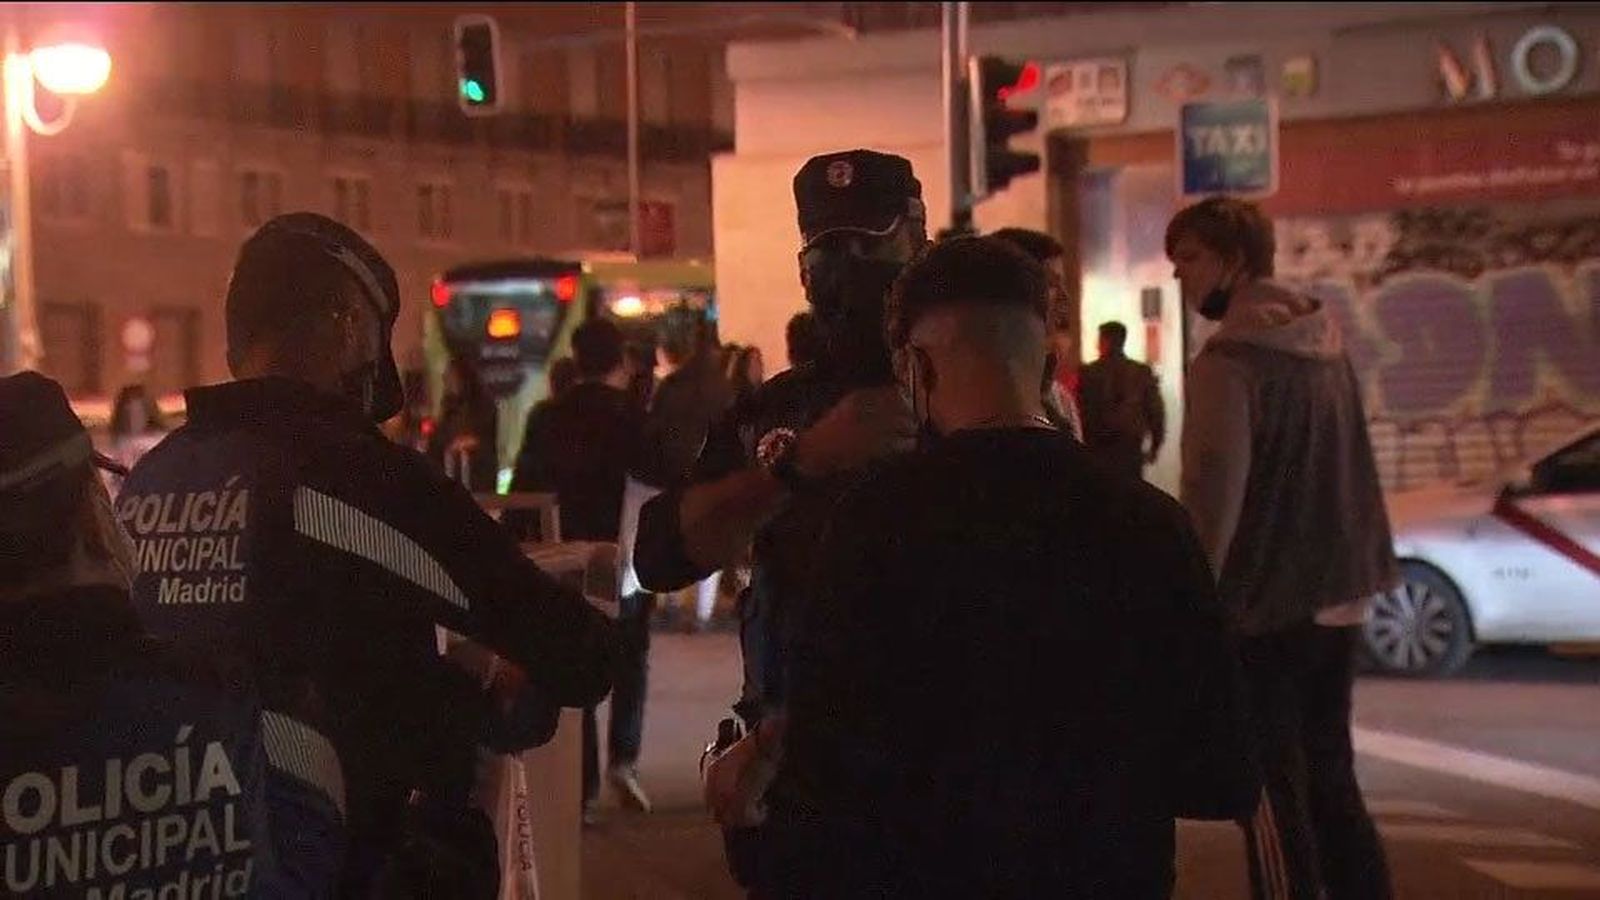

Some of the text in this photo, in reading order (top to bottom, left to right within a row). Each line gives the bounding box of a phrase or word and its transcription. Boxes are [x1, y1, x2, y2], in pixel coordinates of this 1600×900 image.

[1191, 123, 1266, 157] TAXI
[119, 475, 249, 534] POLICÍA
[158, 576, 247, 604] Madrid
[4, 803, 250, 893] UNICIPAL
